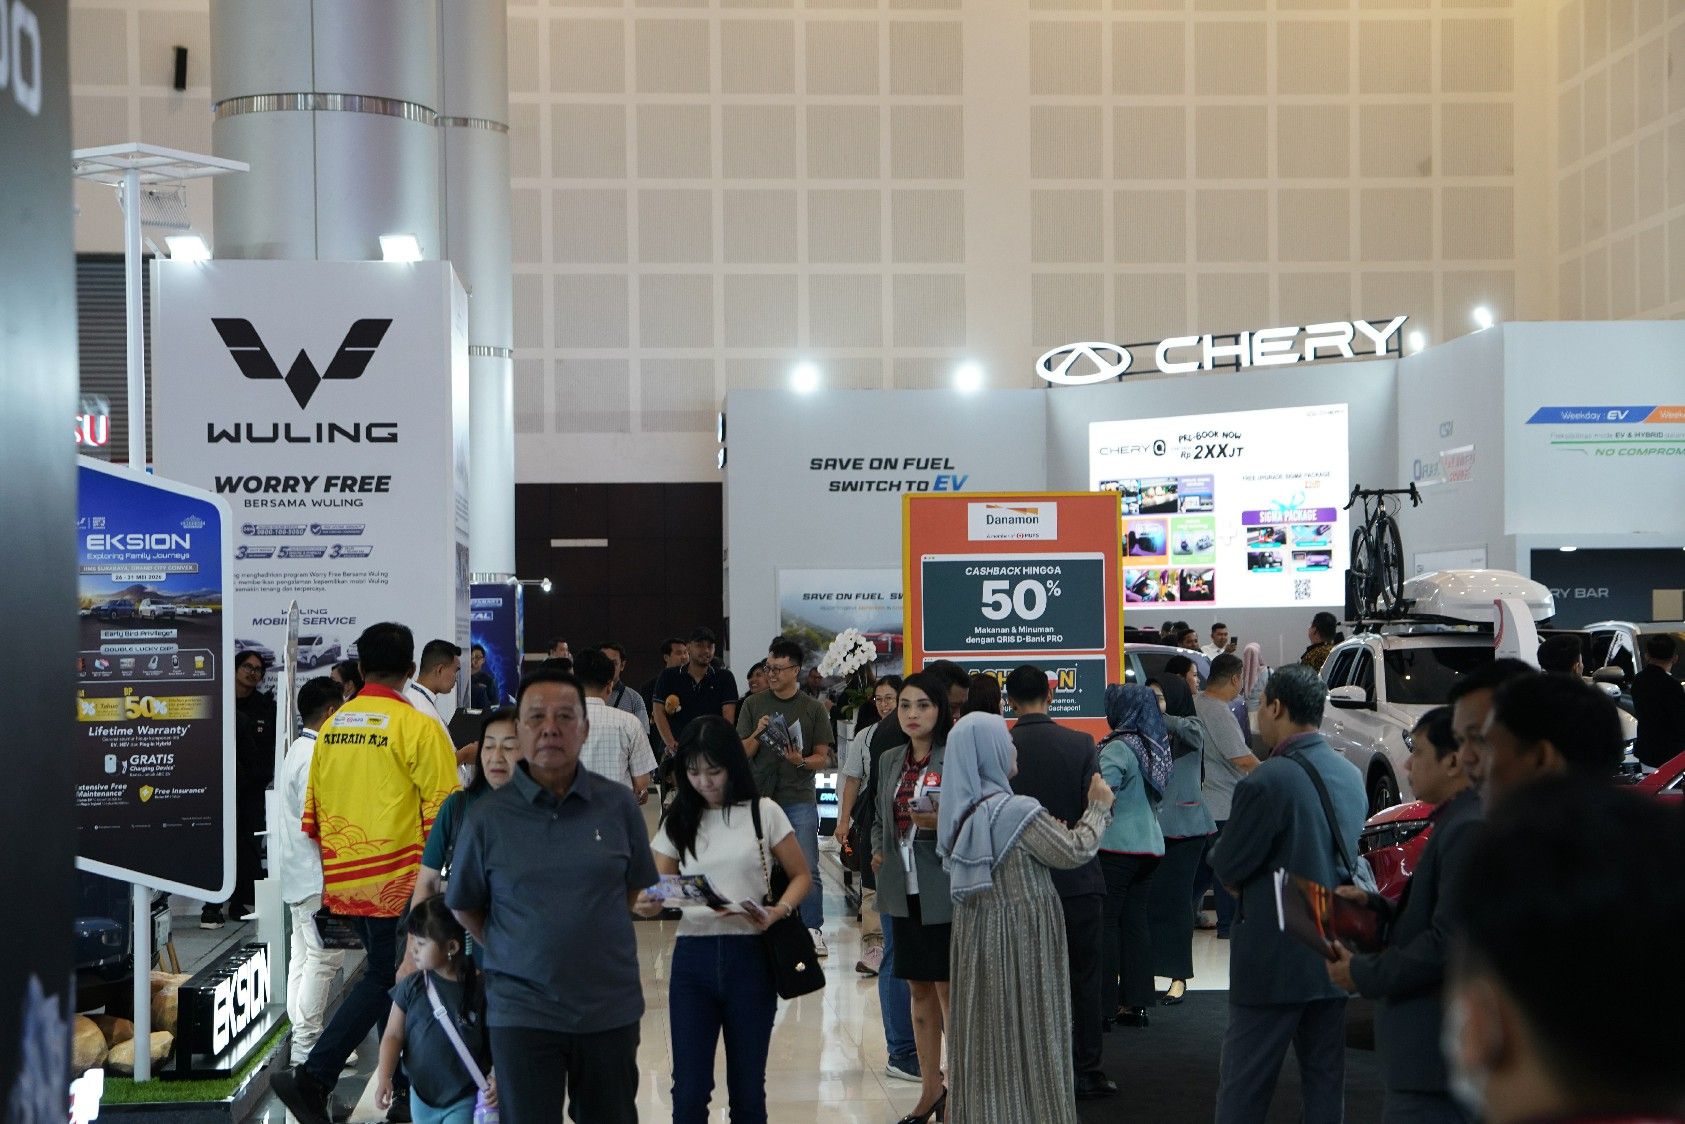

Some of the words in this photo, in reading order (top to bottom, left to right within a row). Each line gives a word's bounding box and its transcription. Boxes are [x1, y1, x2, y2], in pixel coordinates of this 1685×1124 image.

[1155, 315, 1408, 373] CHERY
[1561, 411, 1601, 421] Weekday
[1606, 410, 1629, 420] EV
[207, 422, 398, 443] WULING
[1222, 431, 1242, 440] NOW
[1634, 431, 1664, 439] HYBRID
[1099, 443, 1150, 456] CHERY
[1595, 448, 1616, 456] NO
[1618, 447, 1685, 456] COMPROM
[809, 458, 864, 470] SAVE
[869, 458, 899, 470] ON
[902, 458, 955, 470] FUEL
[214, 475, 319, 493] WORRY
[324, 475, 392, 493] FREE
[829, 480, 901, 492] SWITCH
[905, 480, 929, 492] TO
[933, 474, 969, 491] EV
[244, 498, 306, 508] BERSAMA
[311, 498, 364, 508] WULING
[986, 514, 1039, 525] Danamon
[1284, 509, 1318, 523] PACKAGE
[86, 533, 191, 550] EKSION
[87, 553, 124, 561] Exploring
[125, 552, 151, 561] Family
[152, 552, 190, 561] Journeys
[235, 545, 249, 560] 3
[277, 546, 290, 559] 5
[329, 544, 343, 559] 3
[965, 566, 1022, 576] CASHBACK
[1022, 566, 1062, 575] HINGGA
[802, 592, 833, 601] SAVE
[836, 592, 852, 600] ON
[1574, 587, 1609, 598] BAR
[981, 579, 1062, 621] 50%
[252, 617, 288, 626] MOBI
[302, 616, 357, 625] SERVICE
[104, 630, 124, 638] Early
[974, 626, 1010, 634] Makanan
[1011, 626, 1017, 634] &
[1018, 625, 1054, 633] Minuman
[965, 635, 995, 645] dengan
[996, 635, 1016, 643] QRIS
[1016, 635, 1045, 643] D-Bank
[1046, 634, 1064, 643] PRO
[88, 726, 134, 736] Lifetime
[368, 733, 389, 747] AJA
[129, 754, 174, 765] GRATIS
[129, 765, 155, 773] Charging
[213, 942, 271, 1055] EKSION
